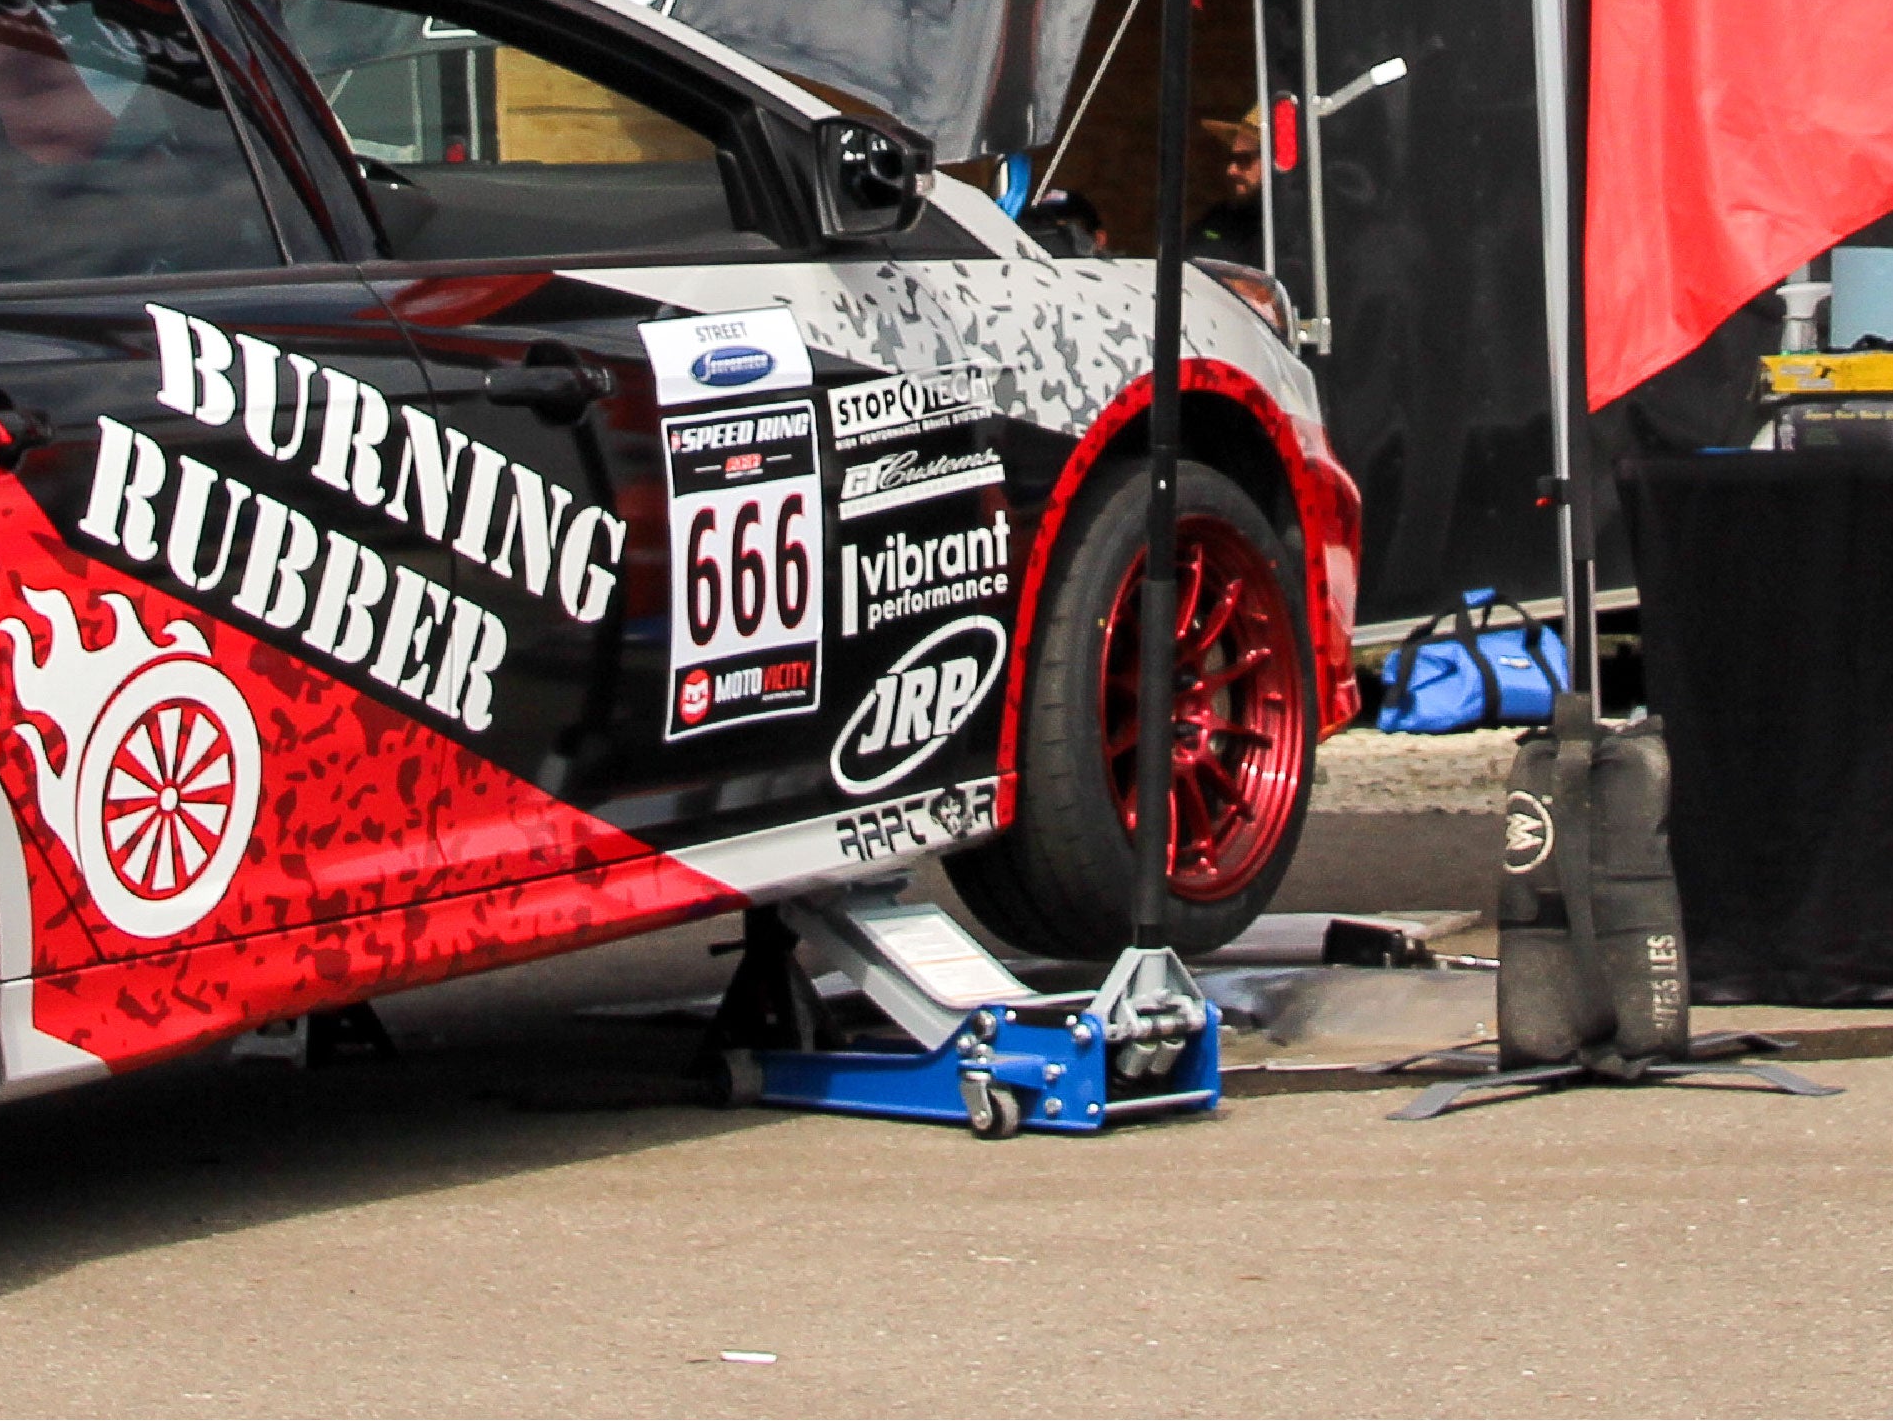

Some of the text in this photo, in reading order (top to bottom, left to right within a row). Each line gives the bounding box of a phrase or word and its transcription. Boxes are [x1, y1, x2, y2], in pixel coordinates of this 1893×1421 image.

[695, 321, 748, 343] STREET
[145, 303, 627, 622] BURNING
[681, 420, 754, 453] SPEED
[756, 413, 810, 442] RING
[78, 415, 508, 732] RUBBER
[687, 494, 811, 647] 666
[861, 510, 1011, 596] vibrant
[867, 573, 1009, 630] performance
[858, 656, 979, 755] JRP
